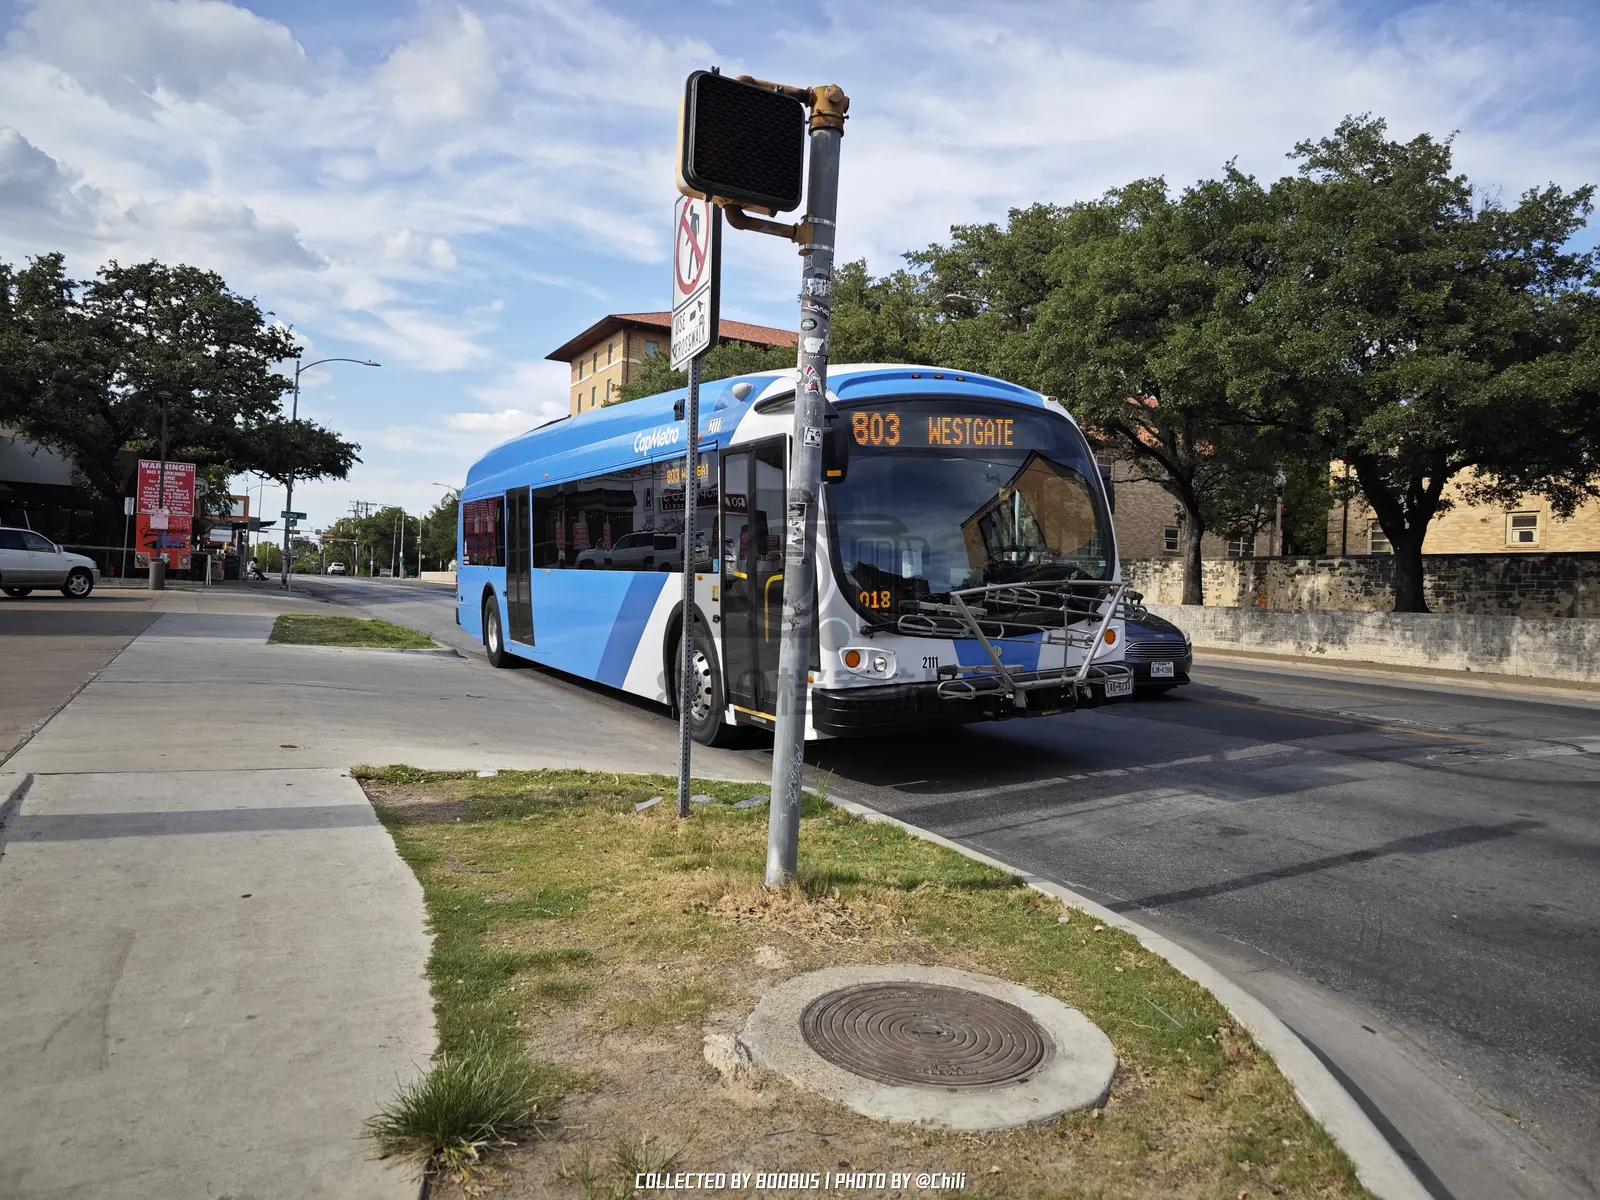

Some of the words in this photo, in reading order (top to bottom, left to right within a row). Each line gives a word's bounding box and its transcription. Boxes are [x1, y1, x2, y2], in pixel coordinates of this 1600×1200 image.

[675, 312, 686, 336] USE
[672, 323, 706, 361] CROSSWALK
[852, 412, 900, 446] 803
[928, 416, 1014, 446] WESTGATE
[633, 426, 680, 457] CapMetro
[666, 468, 680, 485] 803
[860, 590, 891, 609] 018
[922, 656, 939, 669] 2111
